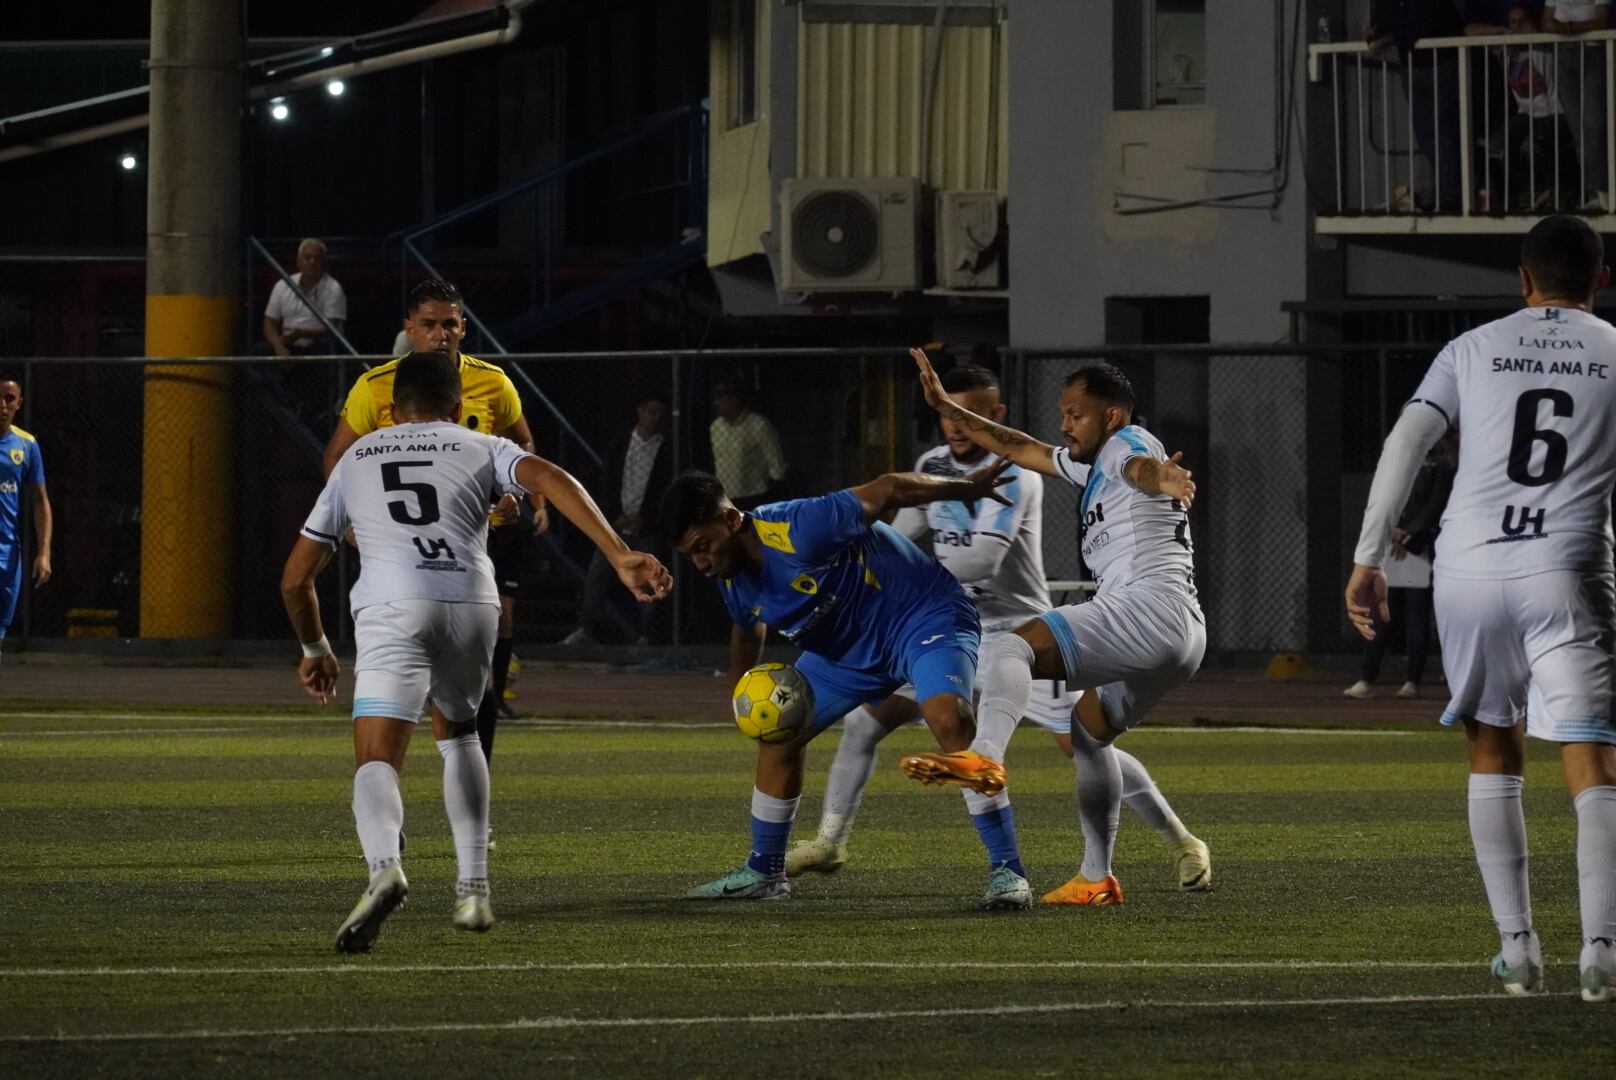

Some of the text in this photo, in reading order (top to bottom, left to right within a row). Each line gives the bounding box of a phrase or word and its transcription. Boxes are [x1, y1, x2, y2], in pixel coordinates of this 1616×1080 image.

[1492, 358, 1609, 379] SANTA ANA FC
[355, 442, 461, 460] SANTA ANA FC
[1507, 388, 1574, 487] 6
[381, 460, 440, 526] 5
[1501, 505, 1546, 536] UH
